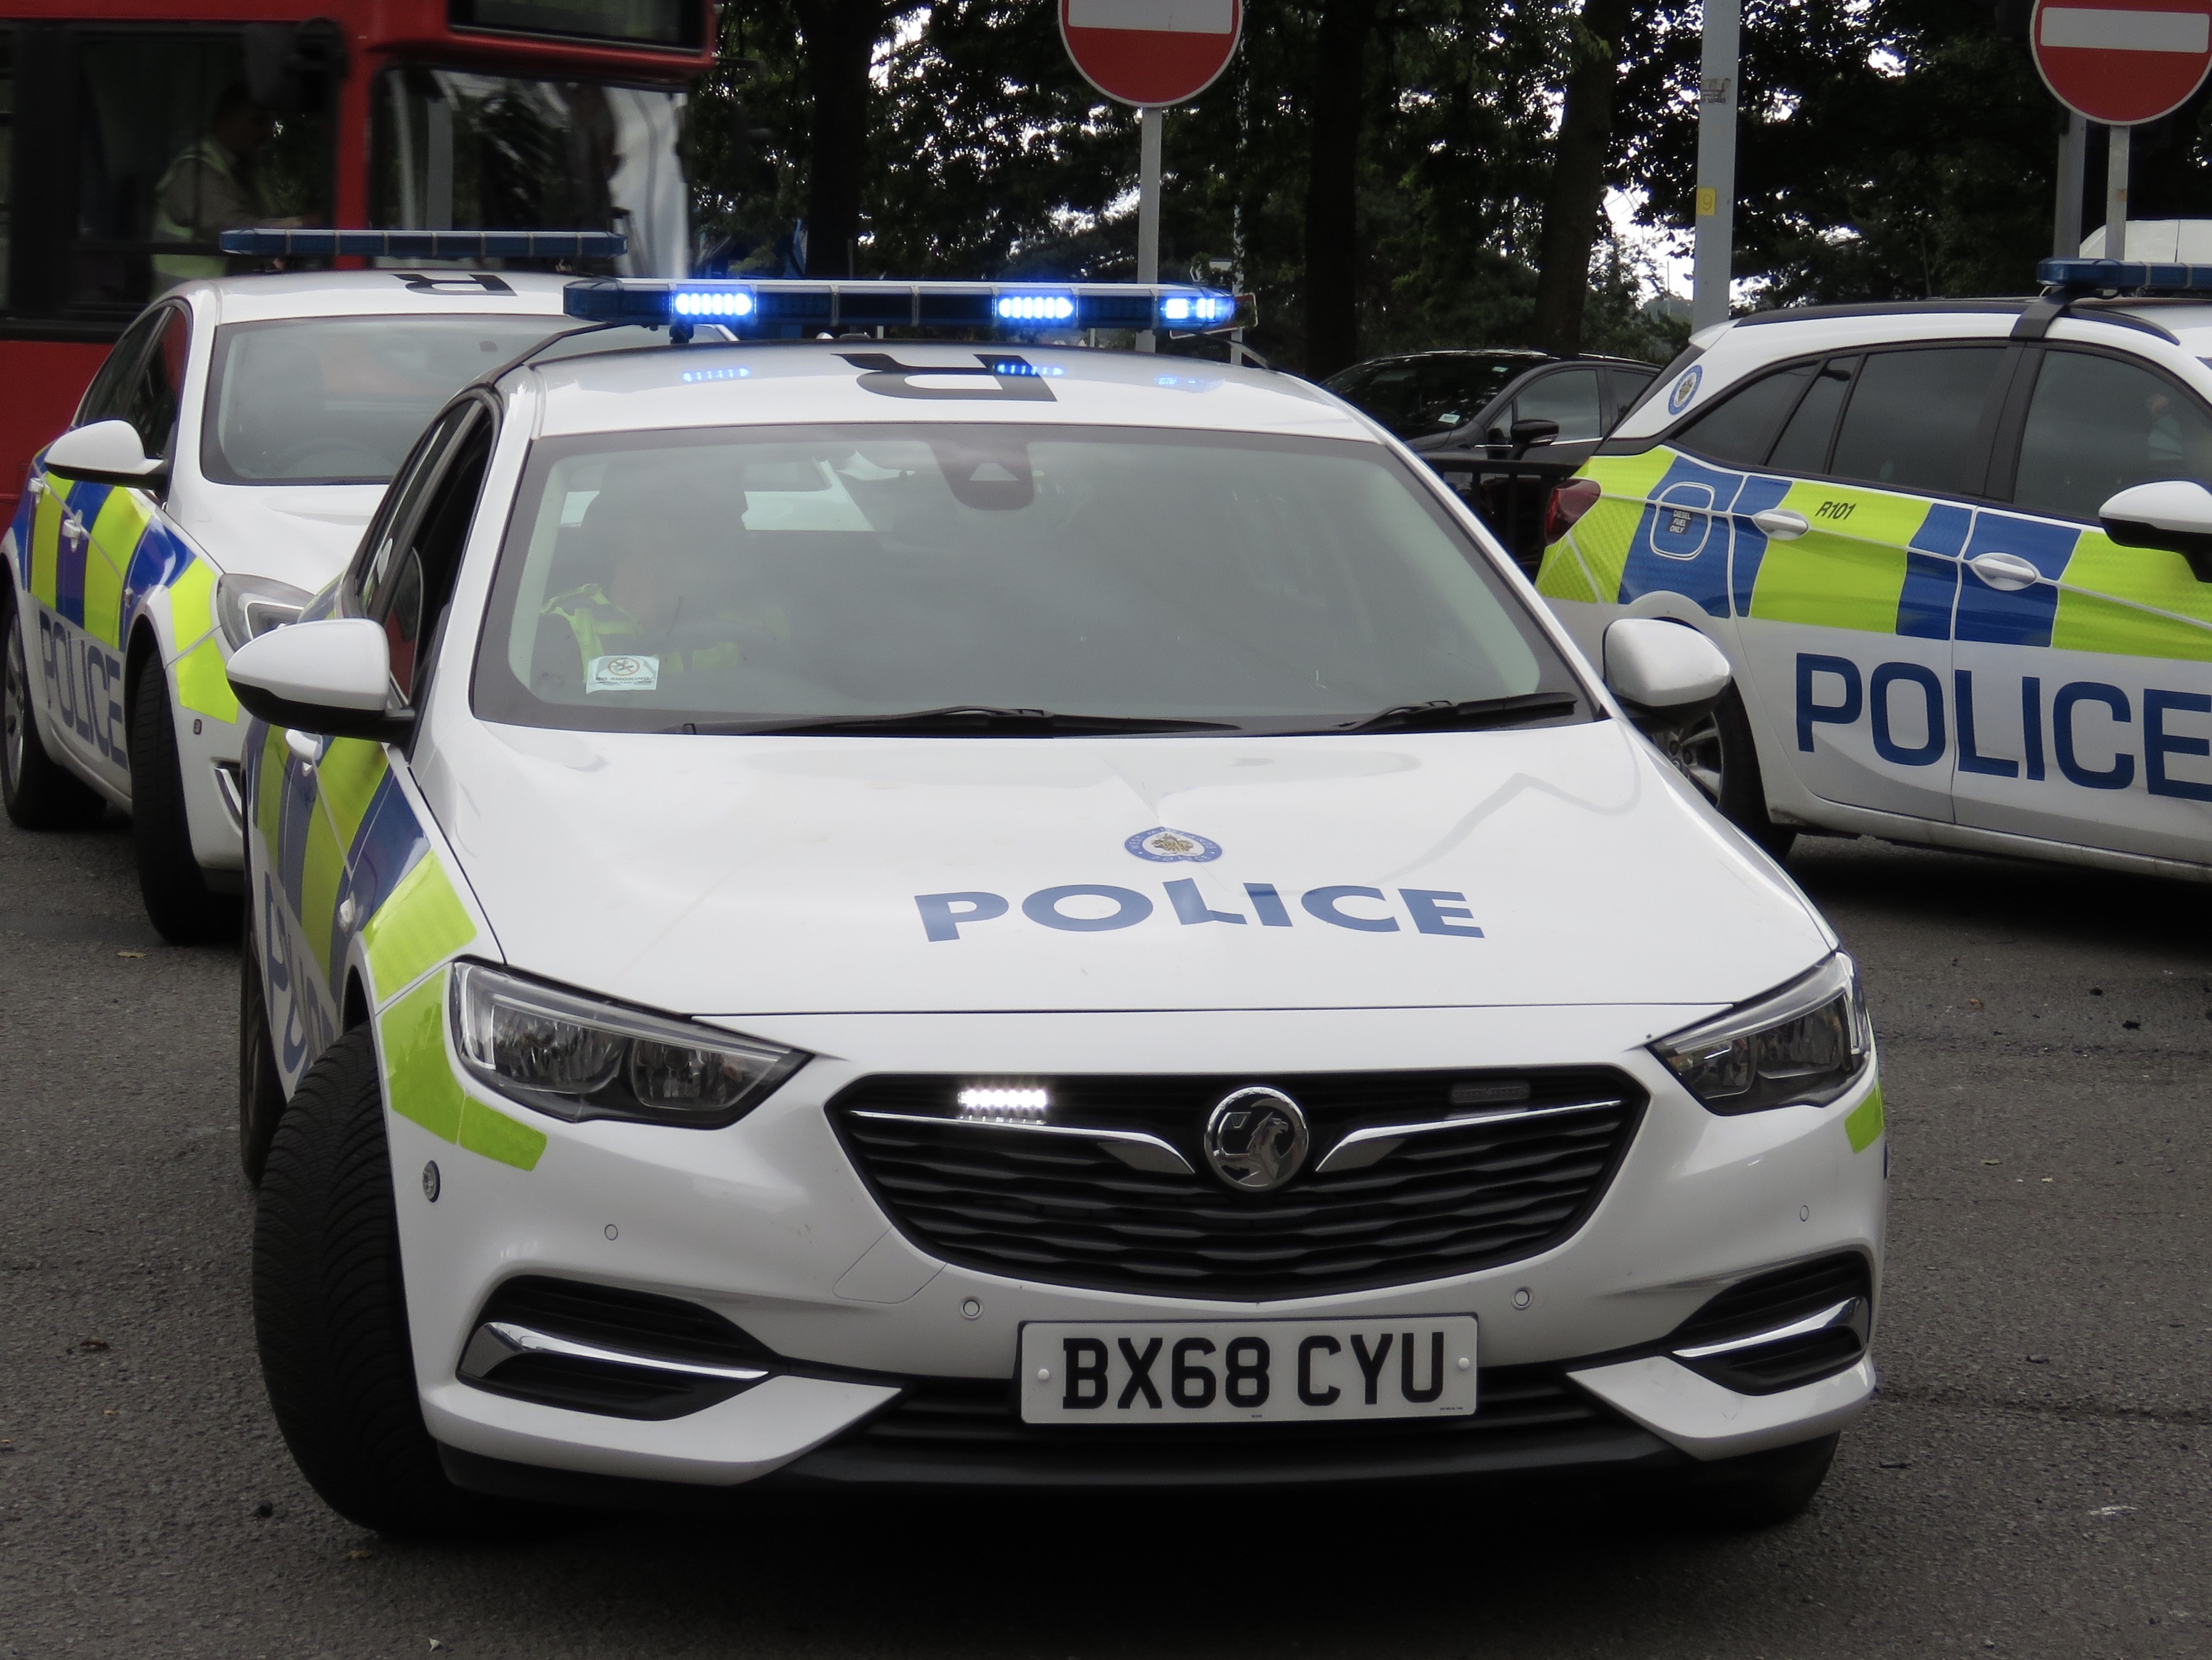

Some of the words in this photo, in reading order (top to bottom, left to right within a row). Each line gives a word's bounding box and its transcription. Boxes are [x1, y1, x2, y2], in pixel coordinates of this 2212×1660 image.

[1669, 525, 1685, 533] ONLY
[1672, 517, 1686, 527] FUEL
[1673, 510, 1691, 520] DIESEL
[1814, 501, 1857, 521] R101
[39, 609, 129, 771] POLICE
[1796, 652, 2212, 802] POLICE
[914, 877, 1485, 943] POLICE
[1062, 1336, 1271, 1409] BX68
[1297, 1331, 1445, 1407] CYU
